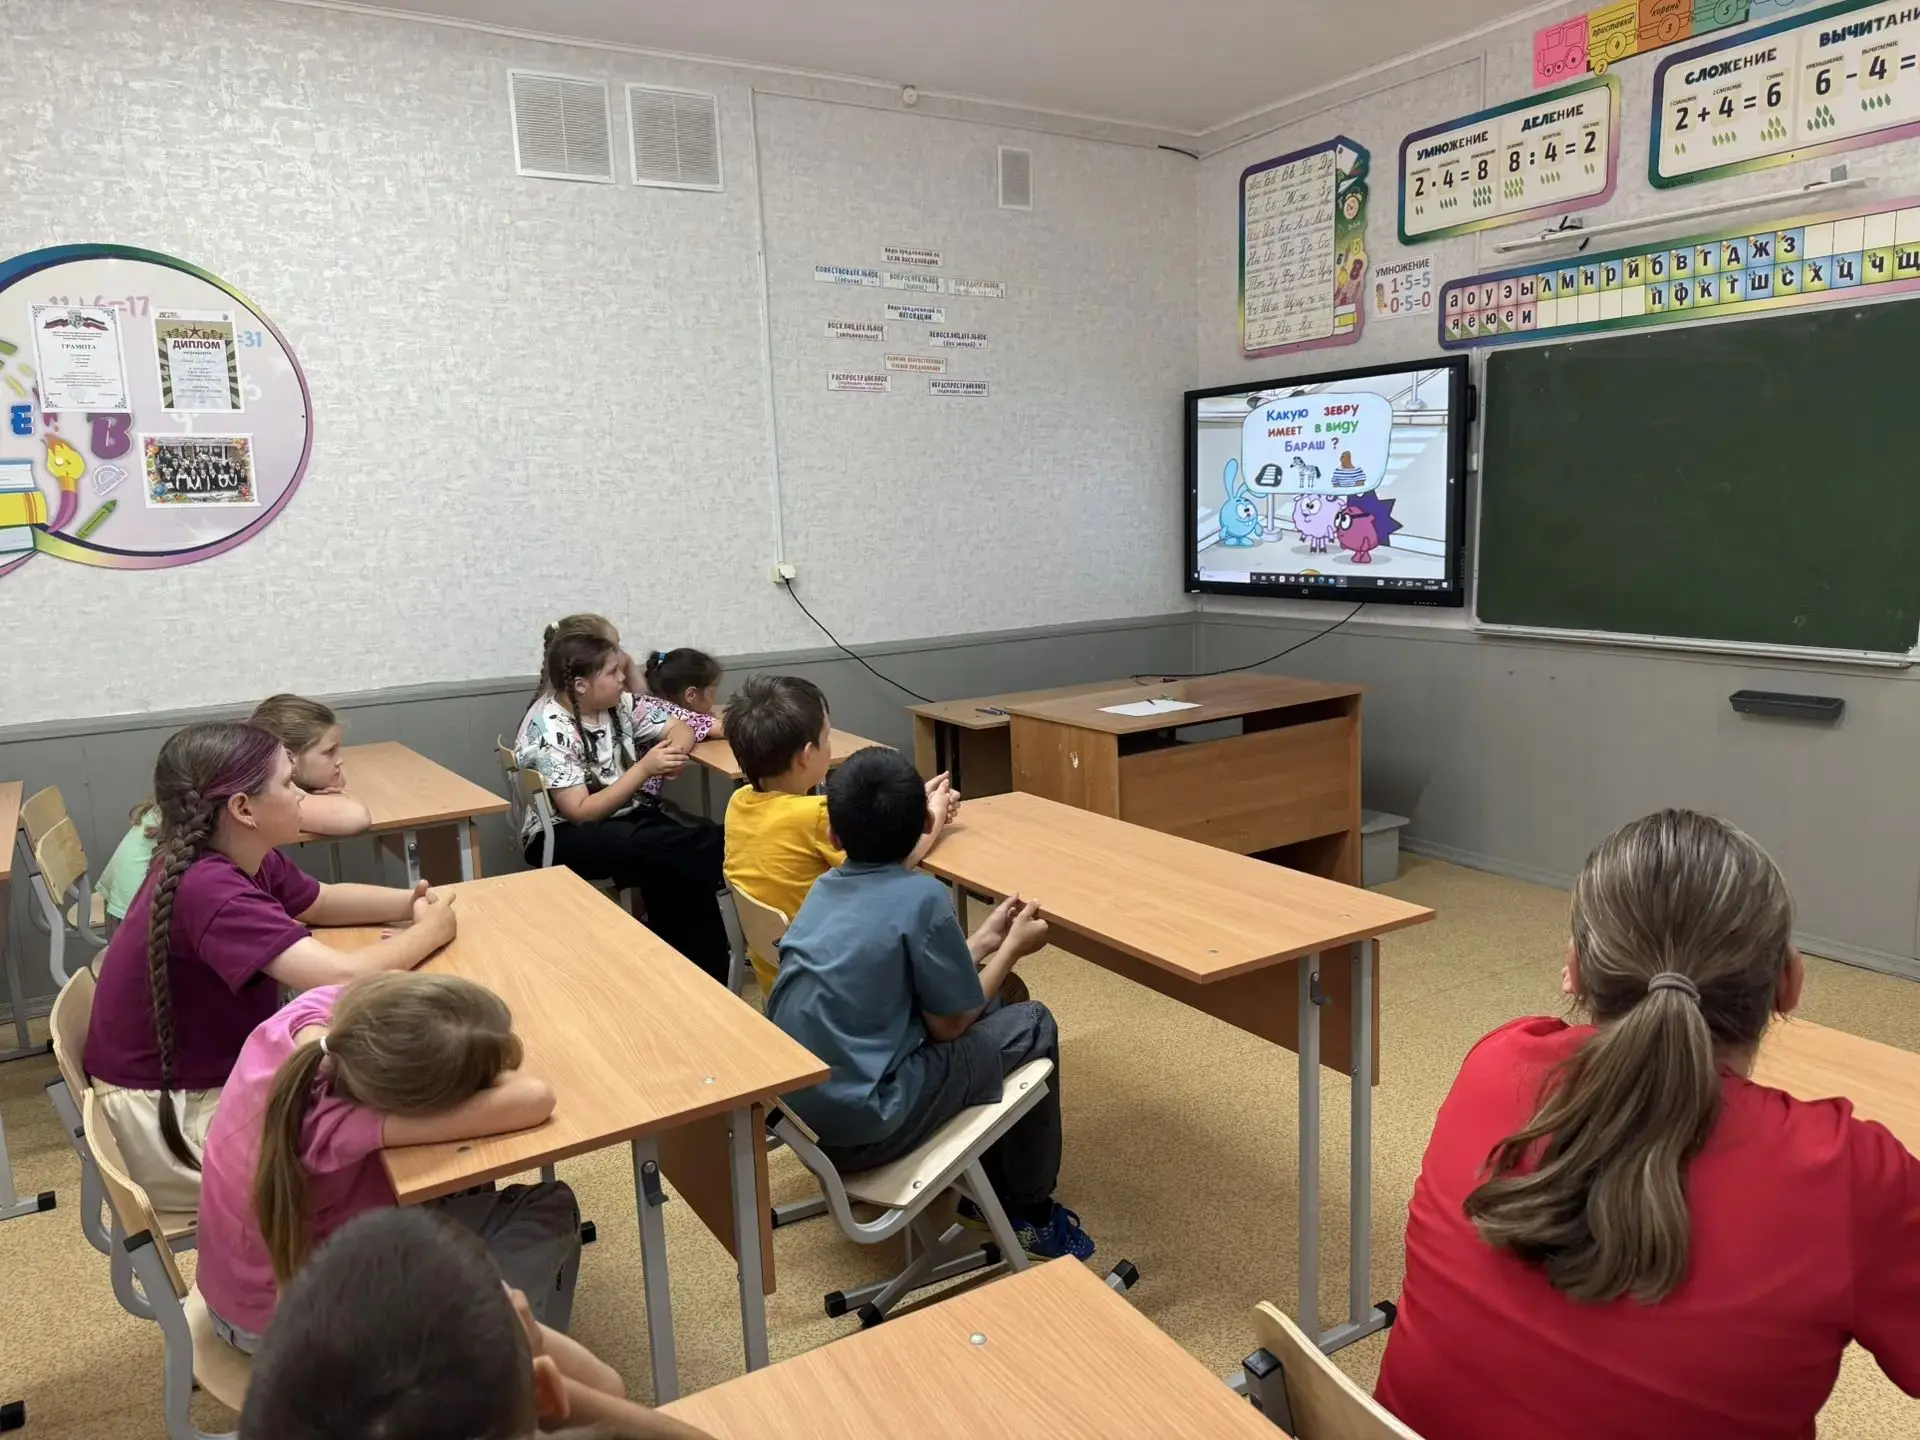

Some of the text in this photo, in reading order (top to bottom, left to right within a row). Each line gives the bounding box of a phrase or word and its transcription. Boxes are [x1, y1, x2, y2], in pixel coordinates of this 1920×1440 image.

[1651, 4, 1680, 16] корень
[1592, 15, 1634, 36] приставка
[1666, 24, 1673, 33] 3
[1684, 48, 1777, 85] СЛОЖЕНИЕ
[1816, 68, 1830, 96] 6
[1869, 56, 1887, 80] 4
[1521, 104, 1584, 132] ДЕЛЕНИЕ
[1675, 107, 1689, 131] 2
[1718, 96, 1734, 118] 4
[1767, 82, 1782, 108] 6
[1417, 131, 1488, 160] УМНОЖЕНИЕ
[1509, 150, 1520, 172] 8
[1544, 142, 1558, 162] 4
[1584, 131, 1596, 154] 2
[1415, 176, 1424, 197] 2
[1442, 169, 1454, 188] 4
[1477, 160, 1488, 180] 8
[1376, 258, 1430, 278] УМНОЖЕНИЕ
[1450, 236, 1796, 308] а о у э ы л м н р й б в г д ж з
[1452, 318, 1459, 330] я
[1468, 314, 1476, 328] ё
[1486, 312, 1496, 325] ю
[1506, 308, 1514, 322] е
[1522, 309, 1532, 324] и
[1651, 289, 1662, 304] п
[1674, 284, 1688, 306] ф
[1701, 281, 1712, 298] к
[1727, 277, 1738, 294] т
[1751, 273, 1769, 290] ш
[1782, 269, 1794, 287] с
[1812, 265, 1823, 282] х
[1839, 261, 1854, 281] ц
[1872, 255, 1884, 272] ч
[172, 340, 221, 350] ДИПЛОМ
[1324, 404, 1360, 417] ЗЕБРУ
[1268, 426, 1302, 438] ИМЕЕТ
